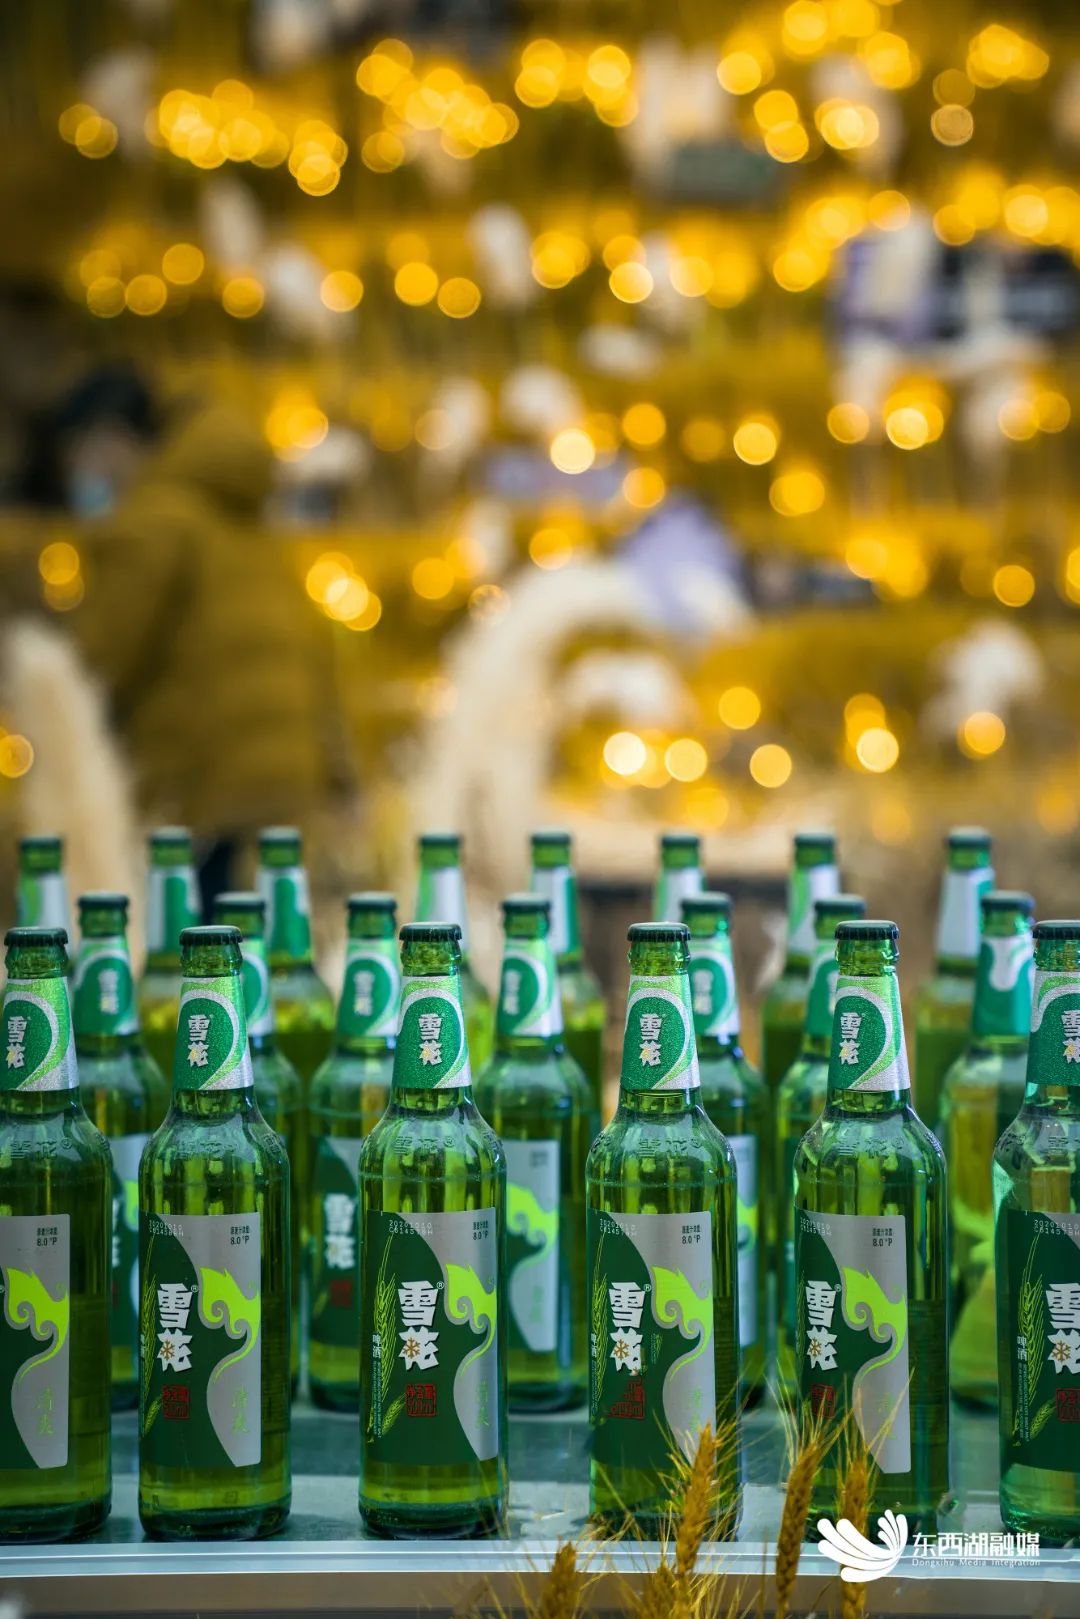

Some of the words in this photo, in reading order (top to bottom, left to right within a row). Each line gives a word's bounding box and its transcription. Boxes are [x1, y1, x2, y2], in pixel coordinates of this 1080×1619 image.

[6, 1016, 27, 1069] 雪花
[187, 1014, 210, 1067] 雪花
[418, 1013, 443, 1066] 雪花
[639, 1013, 662, 1067] 雪花
[839, 1012, 862, 1065] 雪花
[157, 1283, 192, 1373] 雪花
[398, 1280, 439, 1371] 雪花
[609, 1282, 645, 1376] 雪花
[805, 1280, 838, 1371] 雪花
[1046, 1283, 1080, 1374] 雪花
